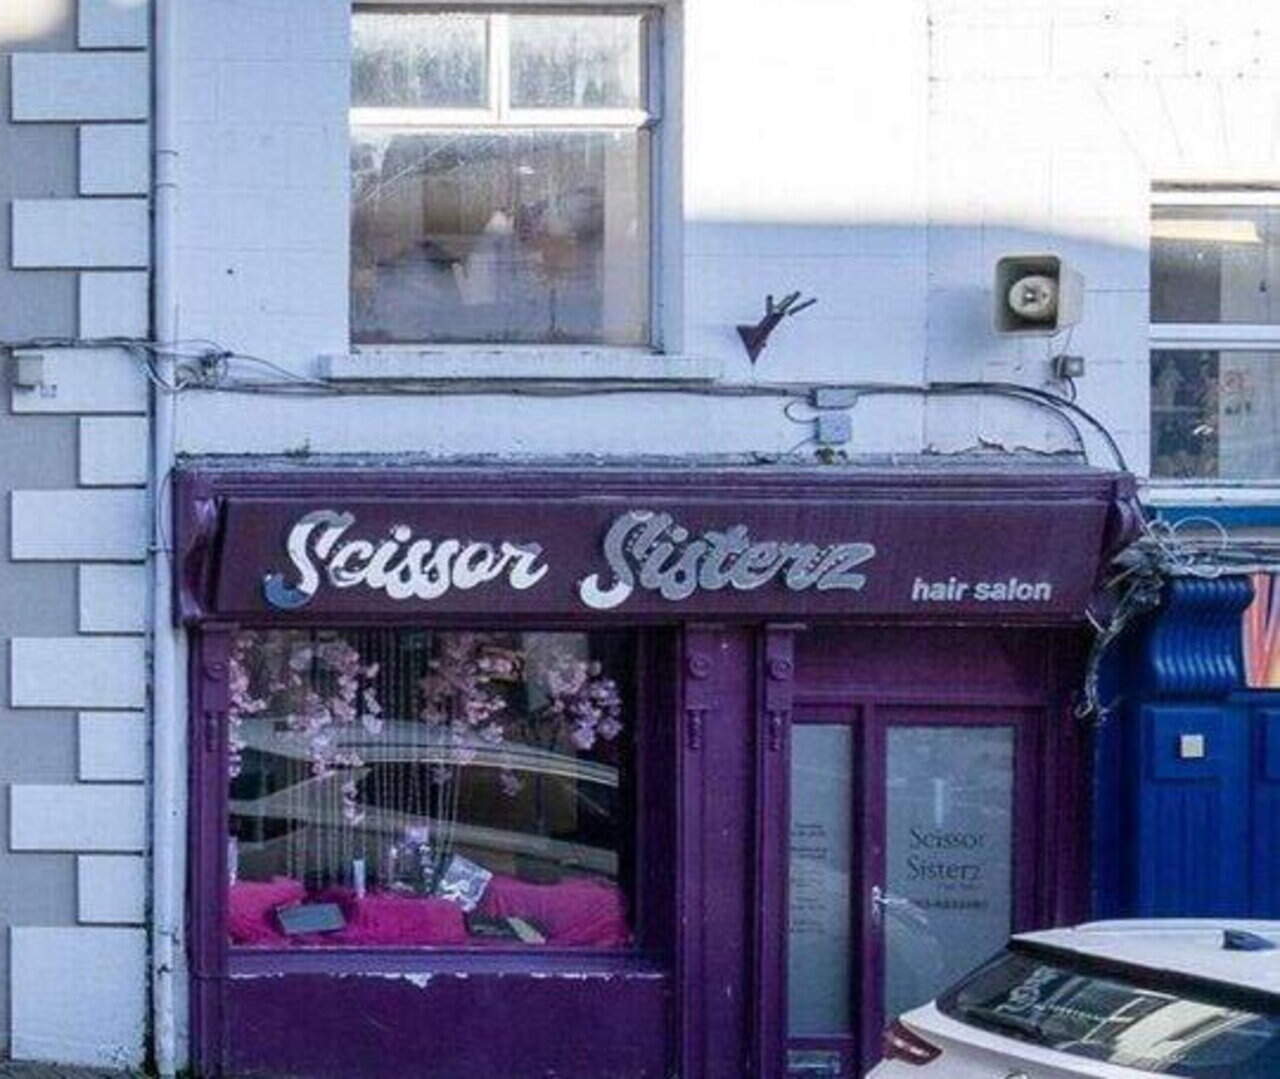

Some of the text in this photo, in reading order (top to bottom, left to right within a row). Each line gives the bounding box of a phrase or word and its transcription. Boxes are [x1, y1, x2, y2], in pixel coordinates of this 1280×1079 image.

[264, 509, 1052, 609] Scissor Sisterz hair salon
